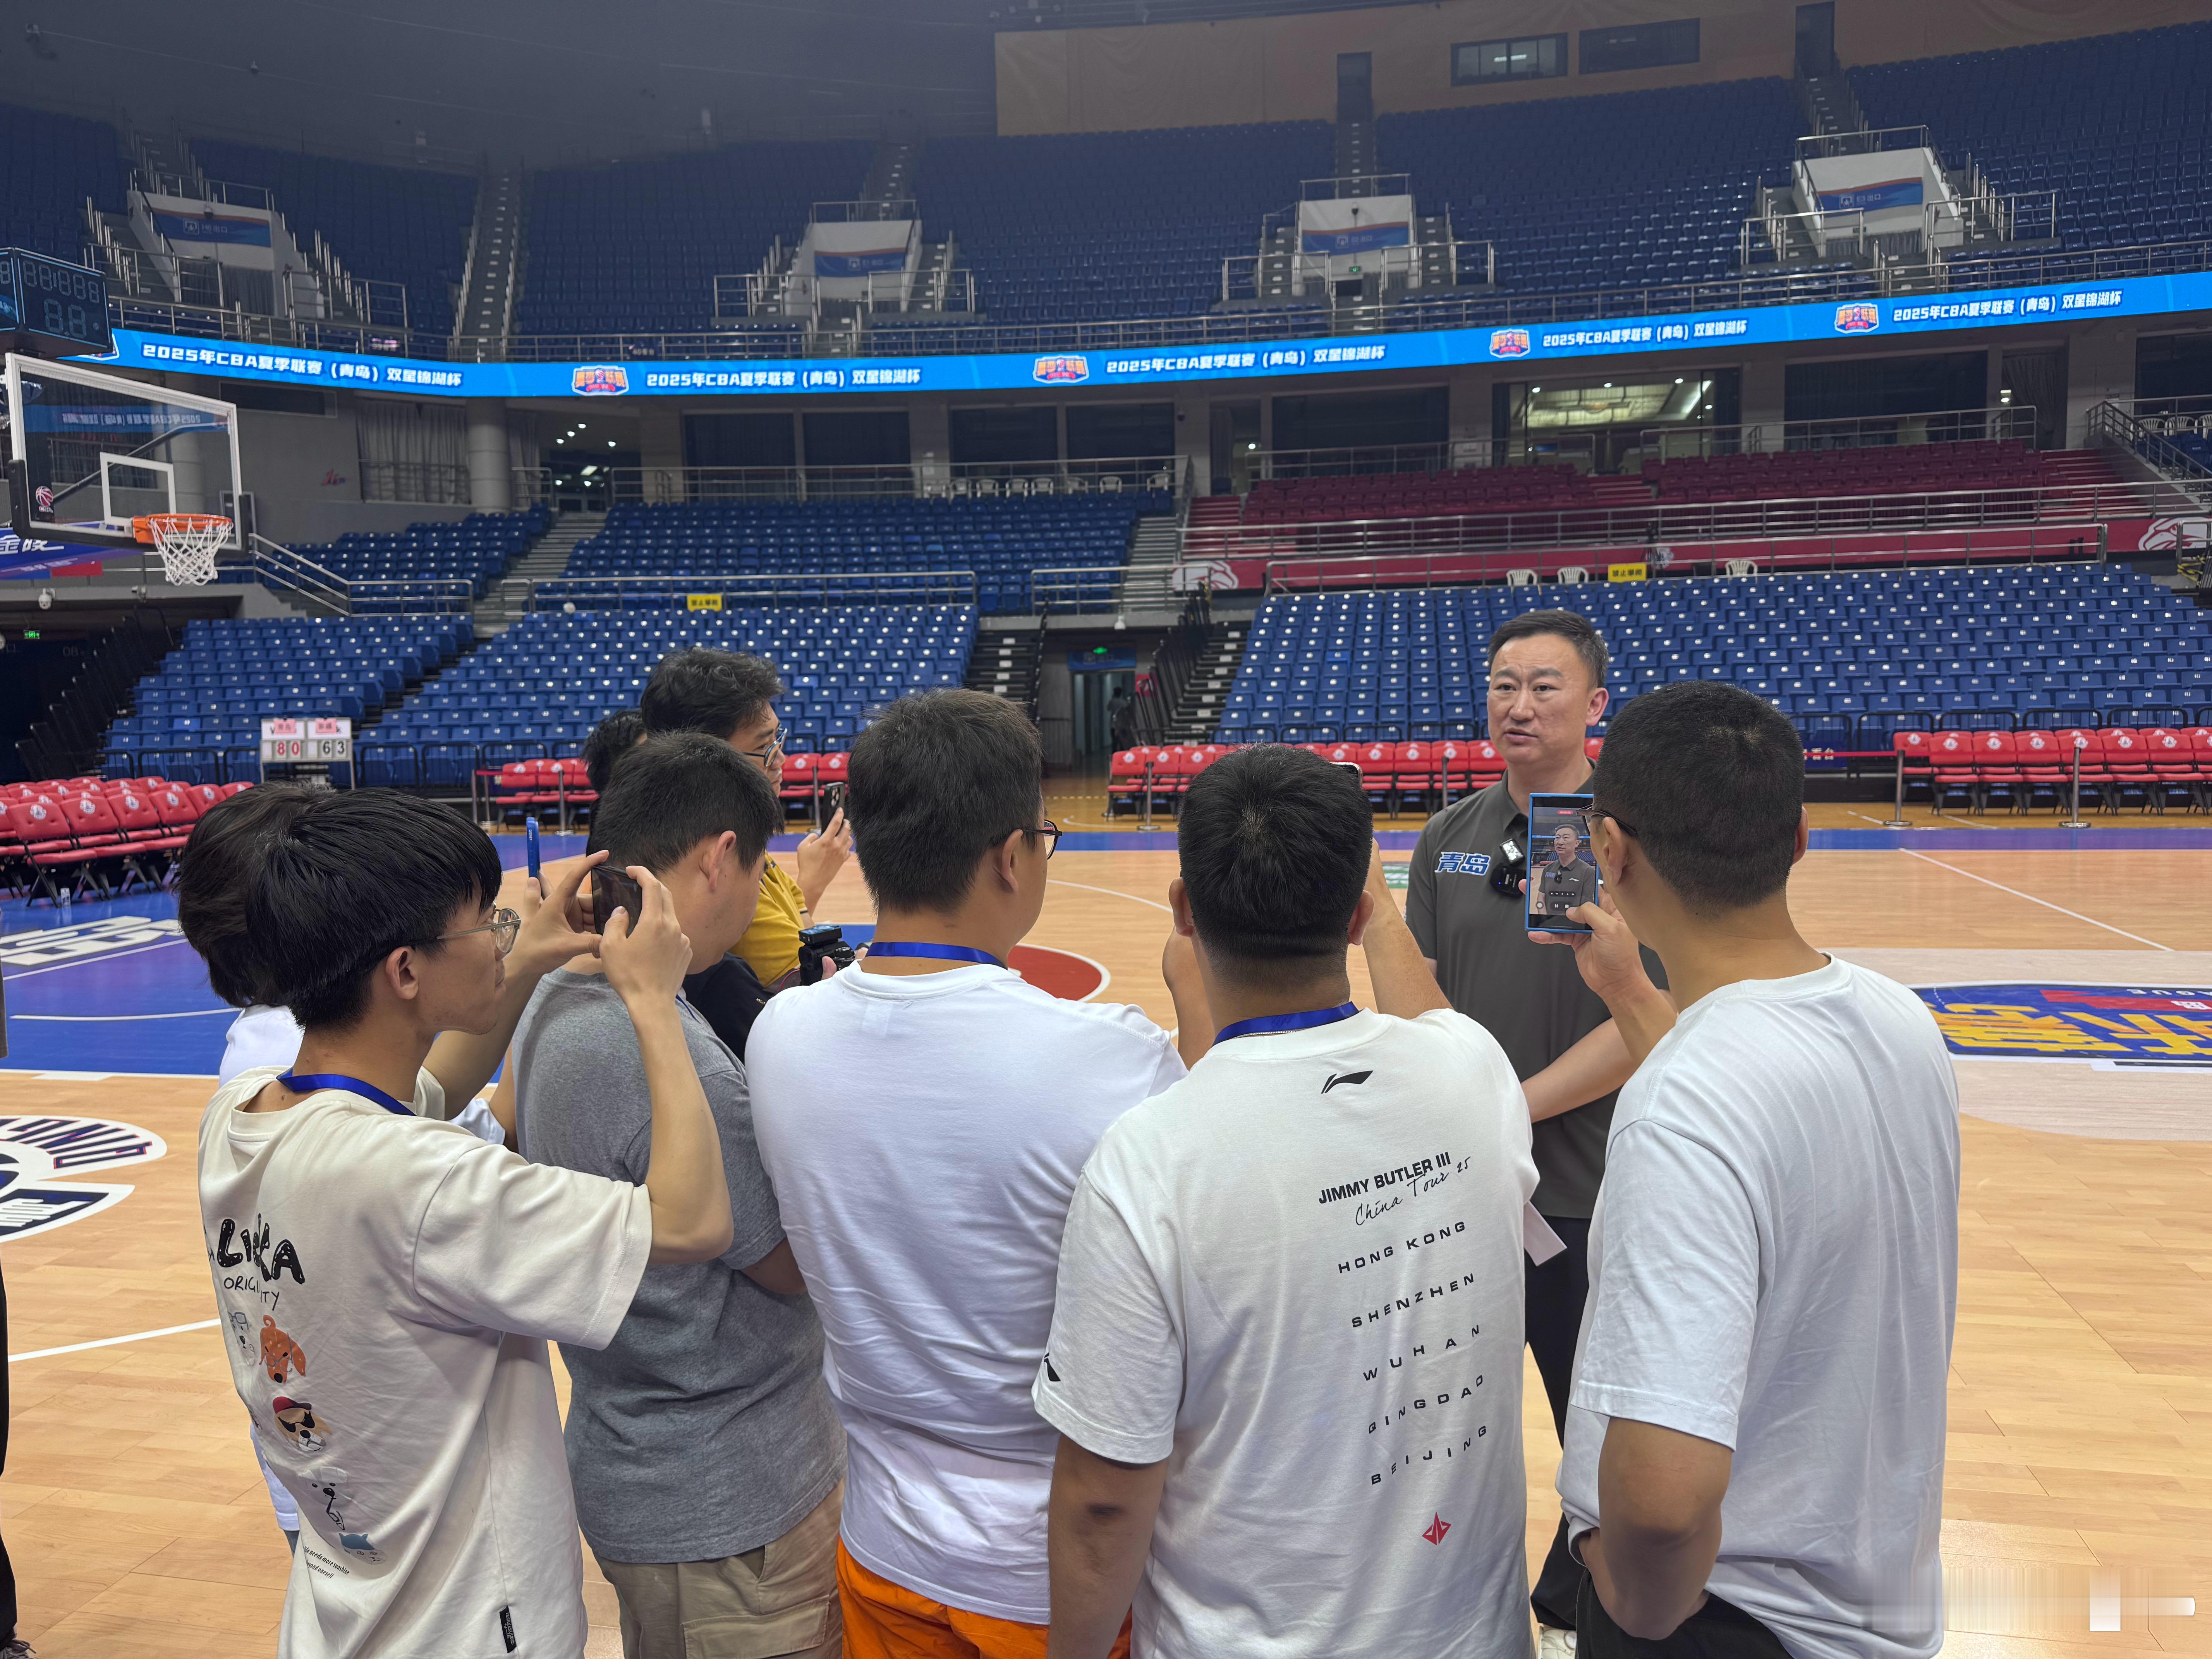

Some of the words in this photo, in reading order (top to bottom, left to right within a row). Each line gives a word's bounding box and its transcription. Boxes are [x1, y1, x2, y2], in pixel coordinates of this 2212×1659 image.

[277, 741, 300, 756] 80
[323, 740, 345, 754] 63
[1434, 852, 1491, 876] 青岛
[1318, 1178, 1369, 1204] JIMMY
[1374, 1159, 1433, 1189] BUTLER
[1435, 1151, 1451, 1168] III
[1355, 1196, 1403, 1226] China
[1406, 1173, 1449, 1197] Tour
[1457, 1156, 1471, 1173] 25
[1338, 1246, 1393, 1273] HONG
[1406, 1221, 1465, 1250] KONG
[1352, 1273, 1474, 1328] SHENZHEN
[1363, 1324, 1480, 1381] WUHAN
[1369, 1375, 1483, 1434] QINGDAO
[1371, 1425, 1486, 1485] BEIJING
